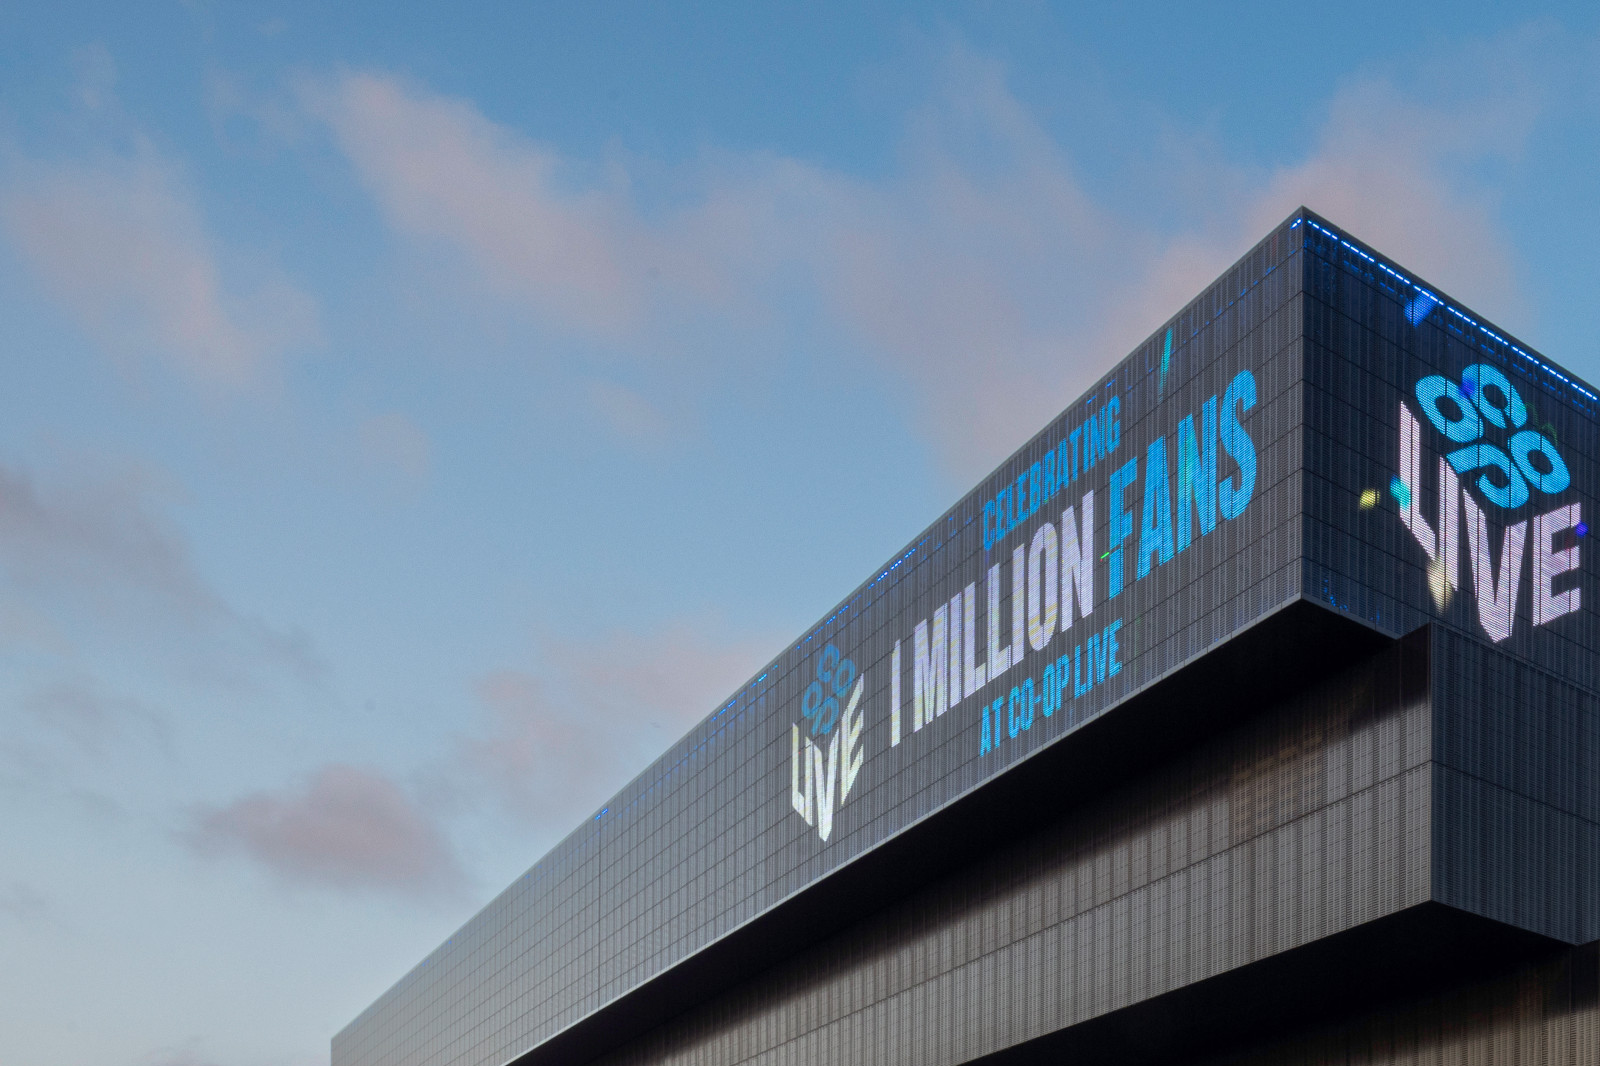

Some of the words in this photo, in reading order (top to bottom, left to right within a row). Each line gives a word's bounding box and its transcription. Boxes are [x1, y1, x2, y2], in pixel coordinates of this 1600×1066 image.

[913, 489, 1094, 733] MILLION
[1108, 369, 1257, 601] FANS
[982, 395, 1120, 551] CELEBRATING
[1400, 400, 1581, 643] LIVE
[792, 673, 864, 842] LIVE
[979, 696, 1004, 757] AT
[1008, 654, 1070, 739] CO-OP
[1074, 617, 1123, 699] LIVE
